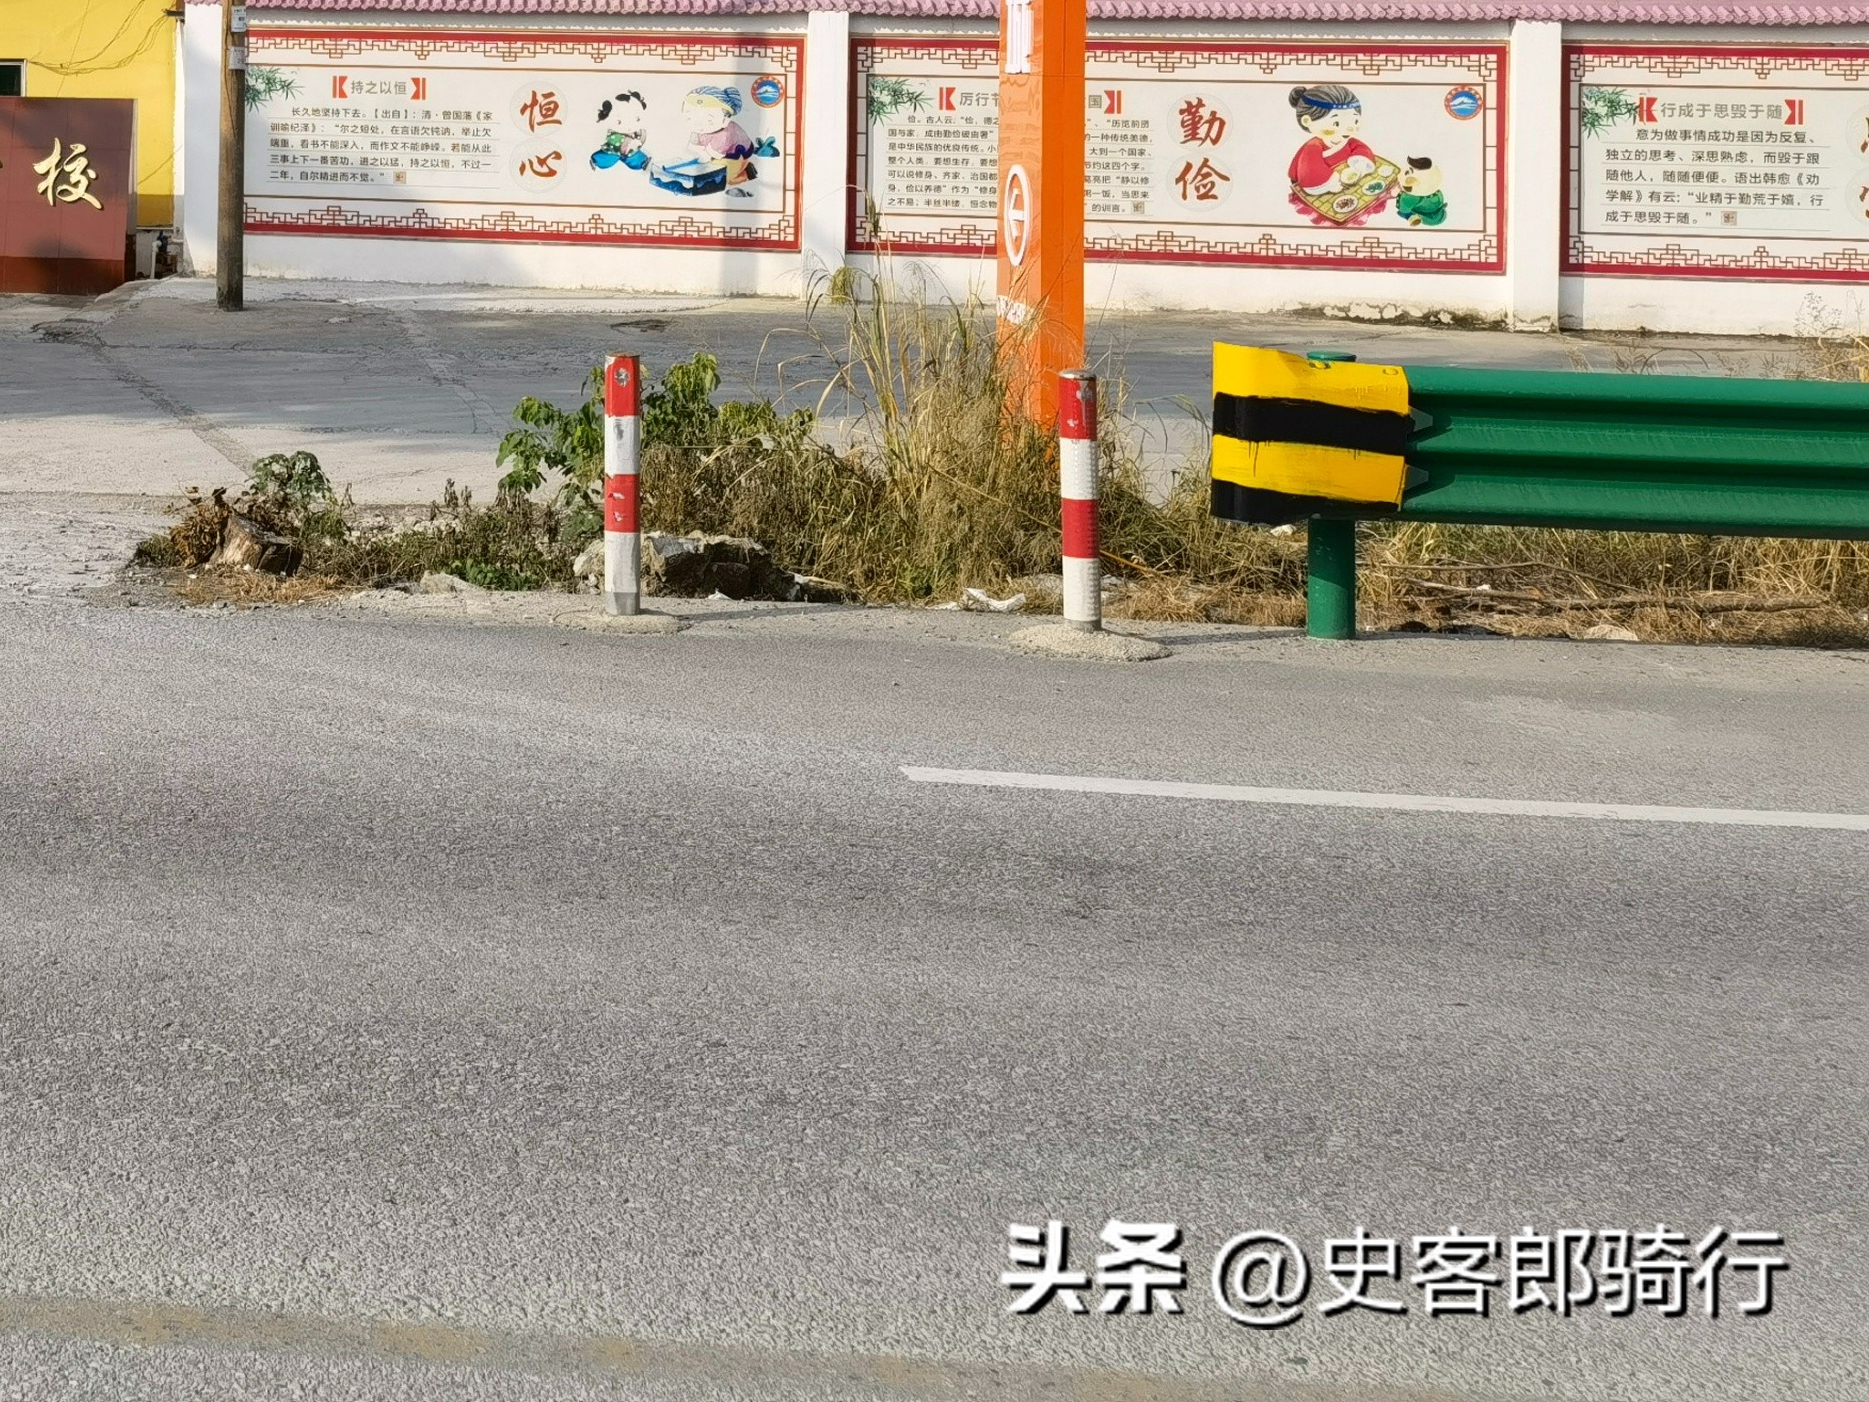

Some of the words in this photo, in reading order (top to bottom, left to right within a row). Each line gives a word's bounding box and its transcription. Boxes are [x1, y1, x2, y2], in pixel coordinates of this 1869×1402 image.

[519, 90, 562, 178] 恒心
[1175, 97, 1231, 201] 勤俭
[1660, 102, 1782, 120] 行成于思毁于随
